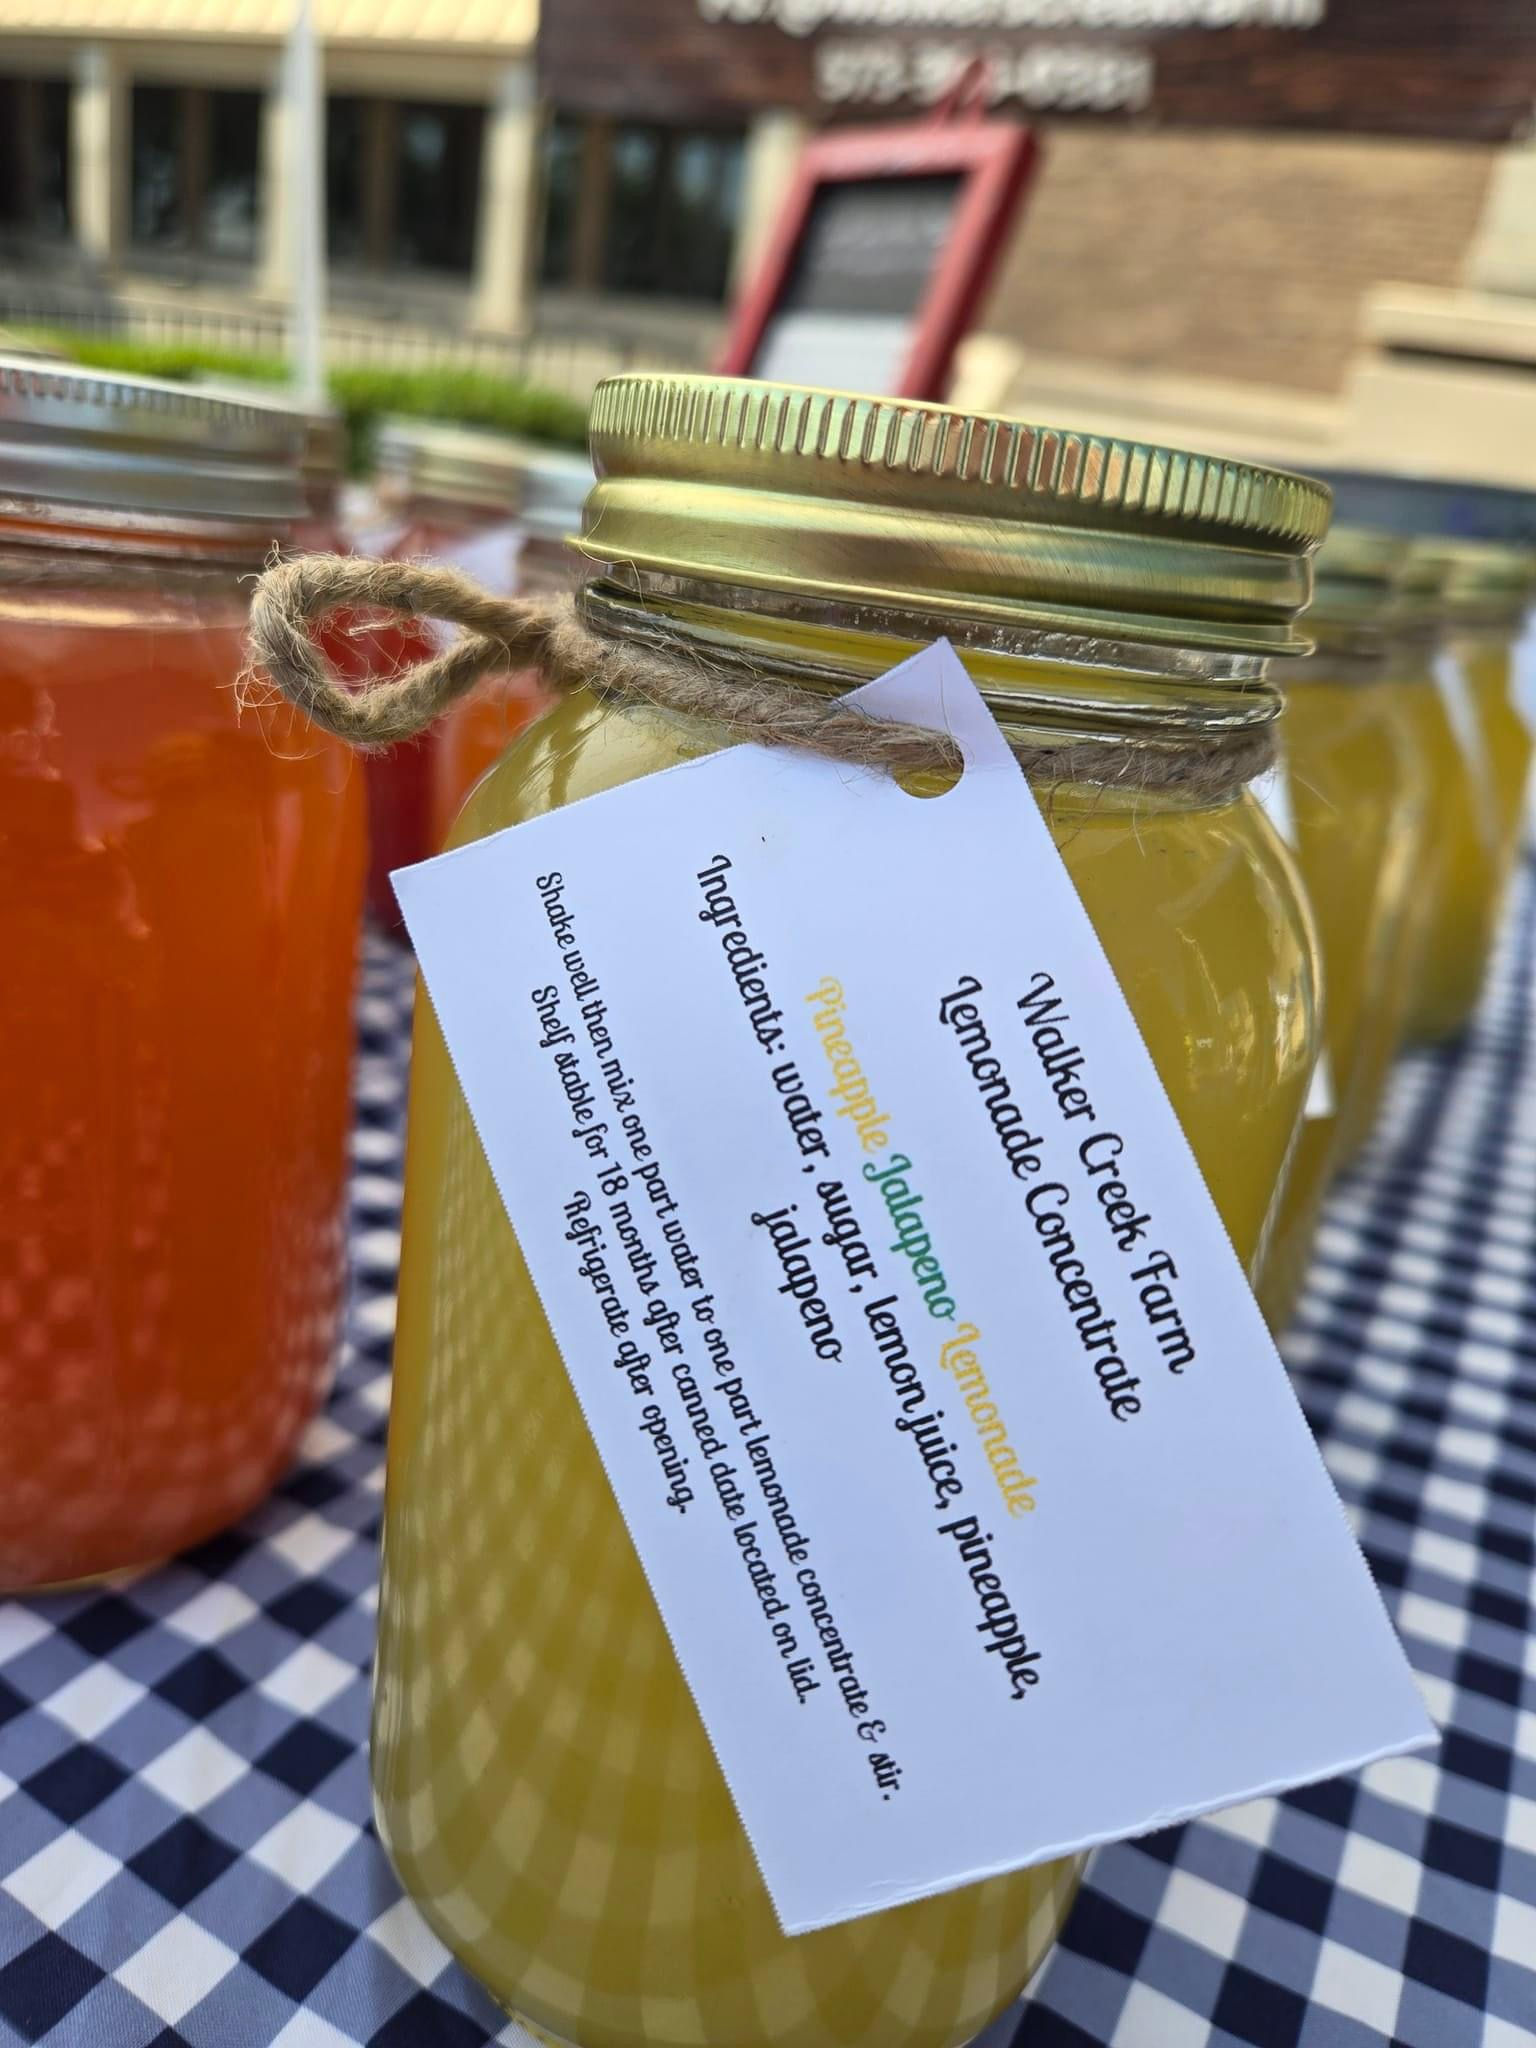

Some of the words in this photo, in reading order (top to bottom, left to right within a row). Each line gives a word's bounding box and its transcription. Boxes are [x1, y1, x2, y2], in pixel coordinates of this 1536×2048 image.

[534, 870, 576, 951] Shake
[561, 948, 600, 1002] well
[695, 853, 786, 1056] Ingredients:
[530, 983, 576, 1049] Shelf
[579, 998, 613, 1060] then
[552, 1050, 596, 1125] stable
[599, 1057, 636, 1114] mix
[770, 1060, 831, 1174] water,
[570, 1121, 609, 1159] for
[620, 1112, 653, 1162] one
[1015, 970, 1097, 1122] Walker
[1077, 1130, 1152, 1253] Creek
[1128, 1249, 1196, 1375] Farm
[595, 1160, 630, 1197] 18
[630, 1160, 679, 1220] part
[937, 974, 1045, 1182] Lemonade
[1023, 1180, 1142, 1423] Concentrate
[607, 1199, 661, 1297] months
[661, 1218, 705, 1289] water
[803, 975, 891, 1153] Pineapple
[861, 1152, 956, 1321] Jalapeno
[938, 1321, 1038, 1517] Lemonade
[814, 1179, 879, 1294] sugar,
[689, 1293, 715, 1325] to
[749, 1202, 843, 1363] jalapeno
[562, 1189, 630, 1339] Refrigerate
[612, 1339, 655, 1396] after
[637, 1403, 695, 1515] opening.
[641, 1297, 685, 1355] after
[702, 1327, 735, 1377] one
[862, 1293, 926, 1414] lemon
[670, 1362, 728, 1460] canned
[712, 1375, 763, 1437] part
[708, 1461, 745, 1521] date
[893, 1408, 963, 1510] juice,
[744, 1433, 811, 1566] lemonade
[732, 1519, 791, 1621] located
[770, 1621, 798, 1660] on
[795, 1567, 869, 1719] concentrate
[935, 1514, 1042, 1701] pineapple,
[785, 1656, 821, 1705] lid.
[855, 1718, 887, 1743] &
[867, 1752, 903, 1801] stir.
